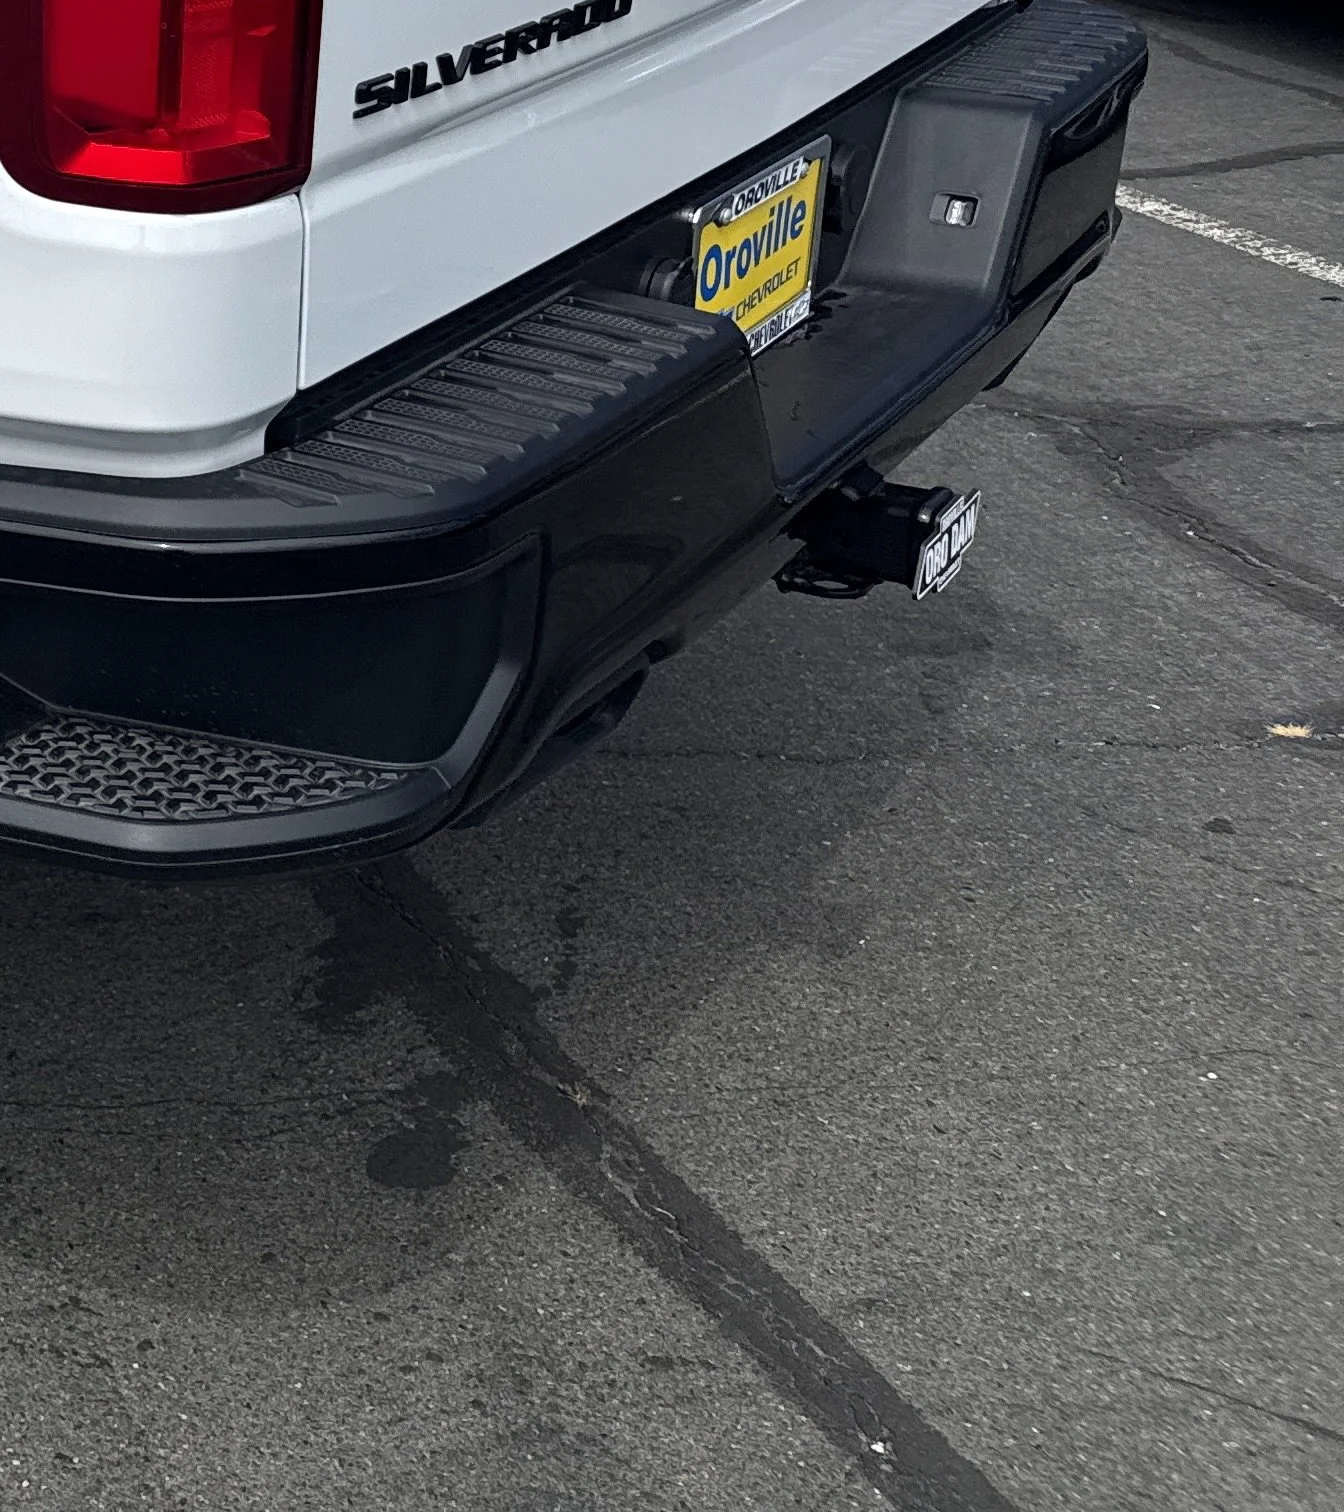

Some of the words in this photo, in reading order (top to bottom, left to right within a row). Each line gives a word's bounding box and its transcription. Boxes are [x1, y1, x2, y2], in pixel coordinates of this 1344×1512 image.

[735, 162, 799, 215] OROVILLE
[700, 194, 807, 302] Oroville
[735, 258, 801, 321] CHEVROLET
[925, 533, 949, 585] ORO
[950, 503, 975, 559] DAM
